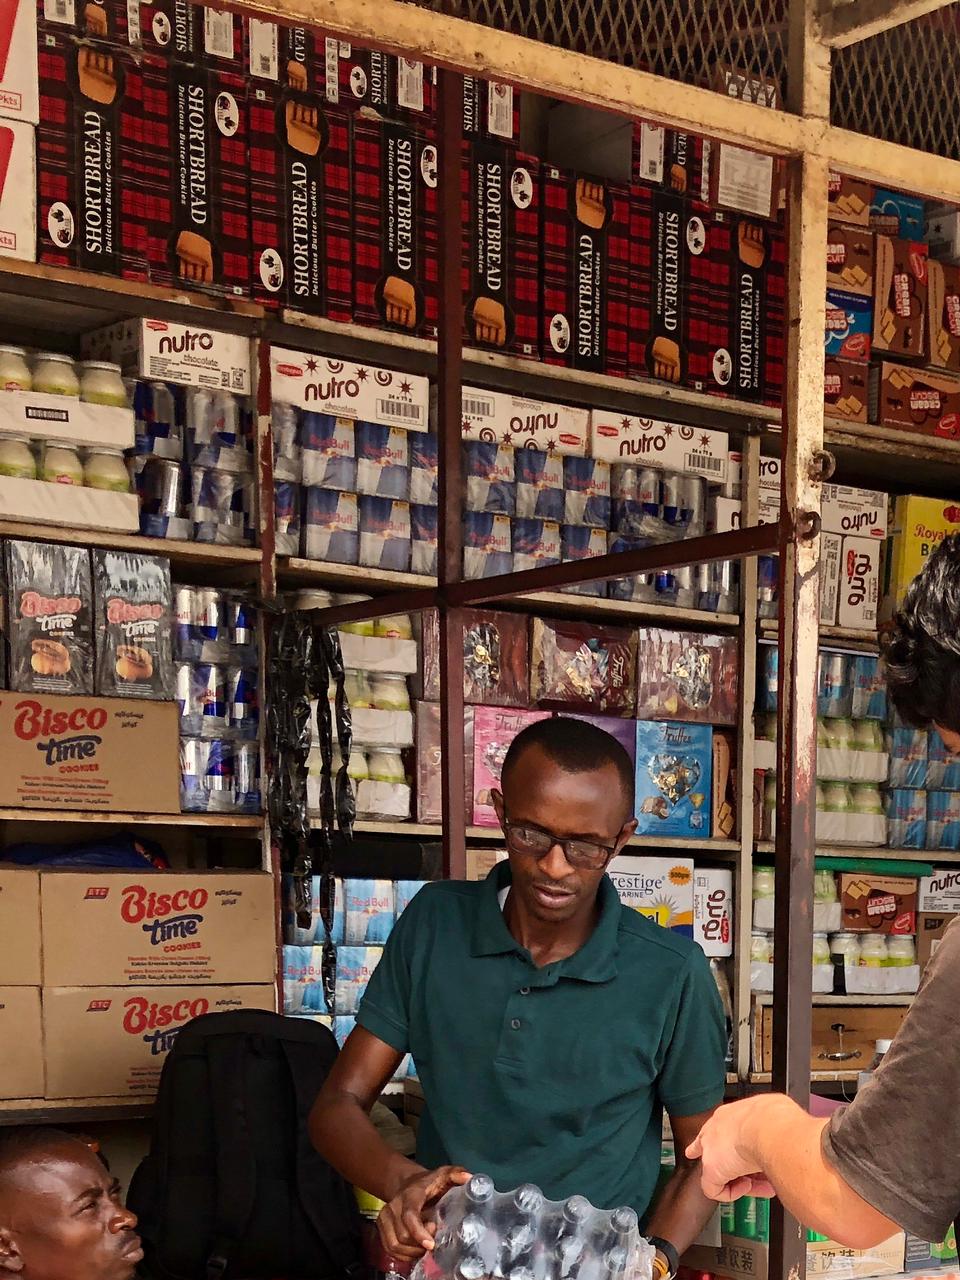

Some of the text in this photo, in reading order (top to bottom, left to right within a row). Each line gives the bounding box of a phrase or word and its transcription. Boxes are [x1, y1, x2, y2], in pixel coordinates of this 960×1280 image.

[104, 131, 112, 170] Cookies
[188, 85, 206, 224] SHORTBREAD
[85, 111, 102, 254] SHORTBREAD
[397, 138, 412, 271] SHORTBREAD
[105, 206, 113, 253] Delicious
[291, 161, 310, 297] SHORTBREAD
[486, 163, 502, 291] SHORTBREAD
[664, 212, 679, 332] SHORTBREAD
[578, 234, 593, 357] SHORTBREAD
[159, 330, 214, 354] nutro
[739, 273, 754, 389] SHORTBREAD
[304, 377, 360, 402] nutro
[510, 411, 559, 433] nutro
[619, 433, 666, 457] nutro
[841, 510, 879, 530] nutro
[913, 523, 947, 540] Royal
[36, 614, 77, 632] time
[121, 620, 160, 638] time
[14, 699, 108, 741] Bisco
[37, 734, 102, 766] time
[370, 896, 390, 908] Bull
[610, 875, 662, 895] restige
[121, 884, 209, 924] Bisco
[143, 913, 203, 945] time
[163, 941, 202, 953] COOKIES
[123, 996, 209, 1036] Bisco
